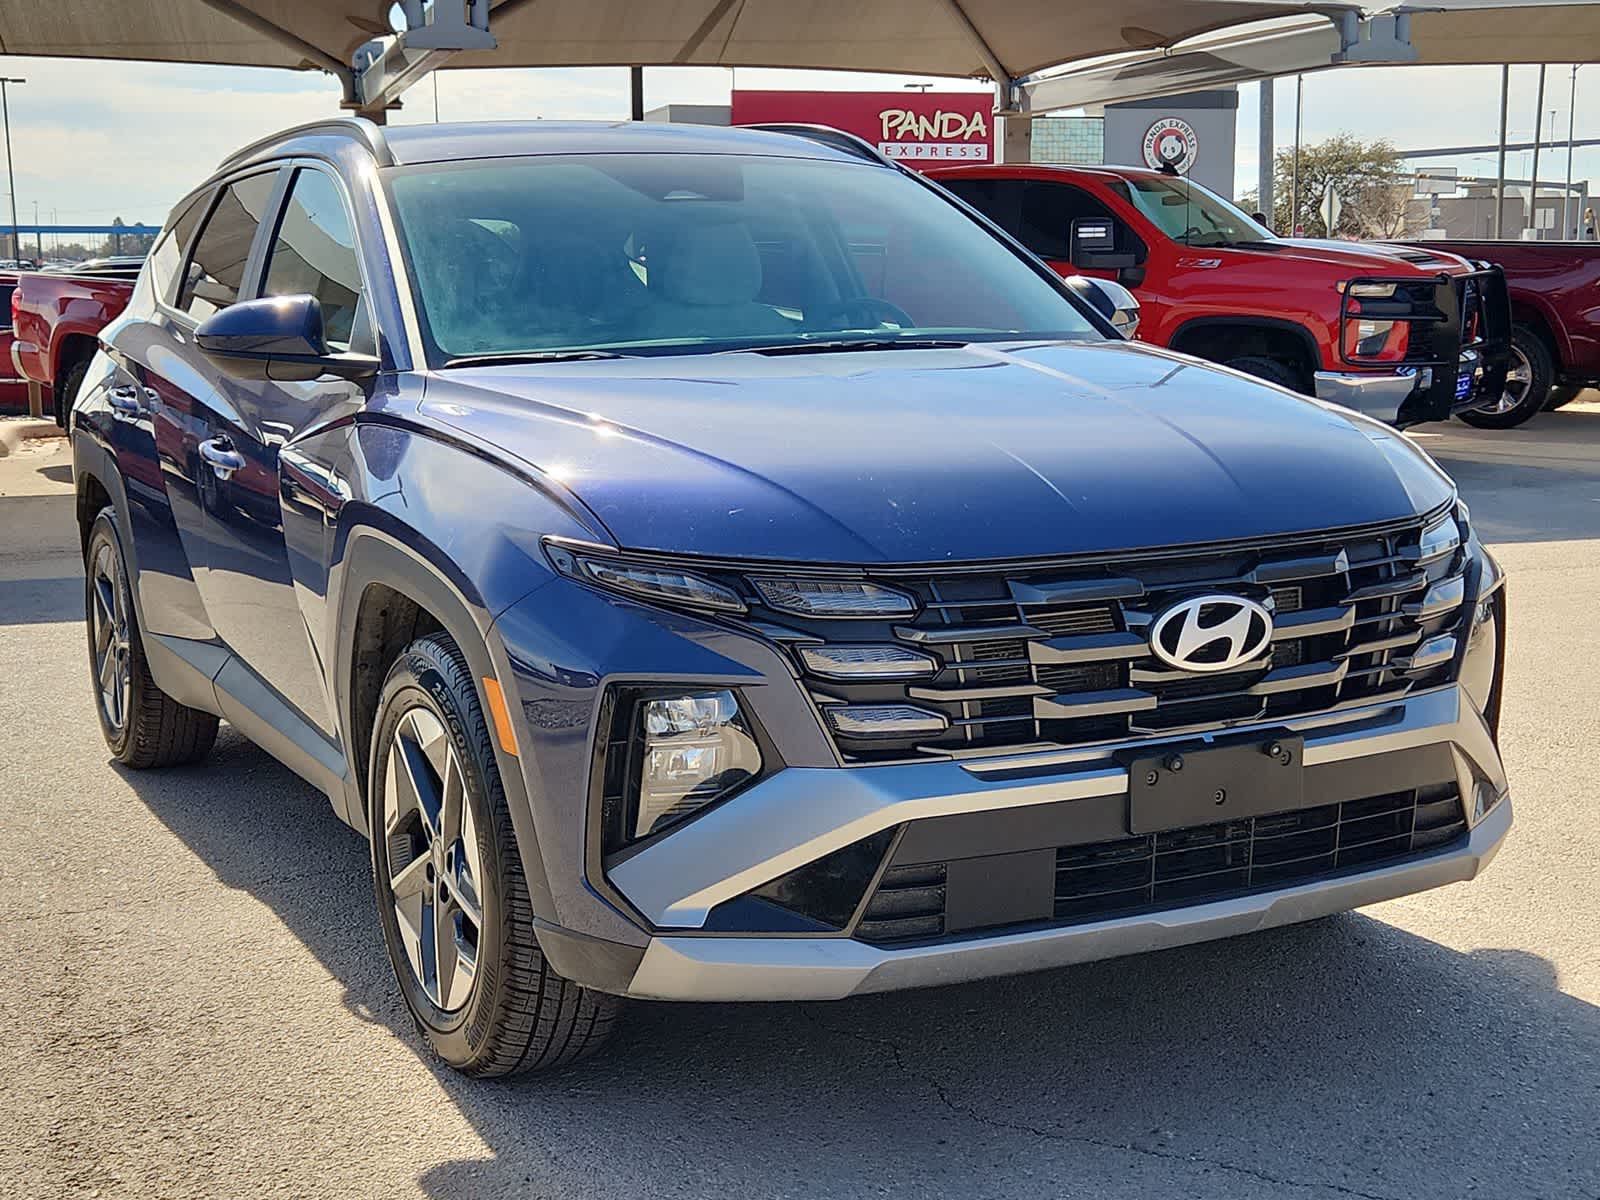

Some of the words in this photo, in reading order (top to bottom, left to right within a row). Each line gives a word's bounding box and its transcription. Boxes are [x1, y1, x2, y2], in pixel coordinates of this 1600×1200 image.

[879, 109, 987, 141] PANDA
[1145, 122, 1167, 149] PANDA
[1169, 120, 1196, 148] EXPRESS
[884, 145, 982, 157] EXPRESS
